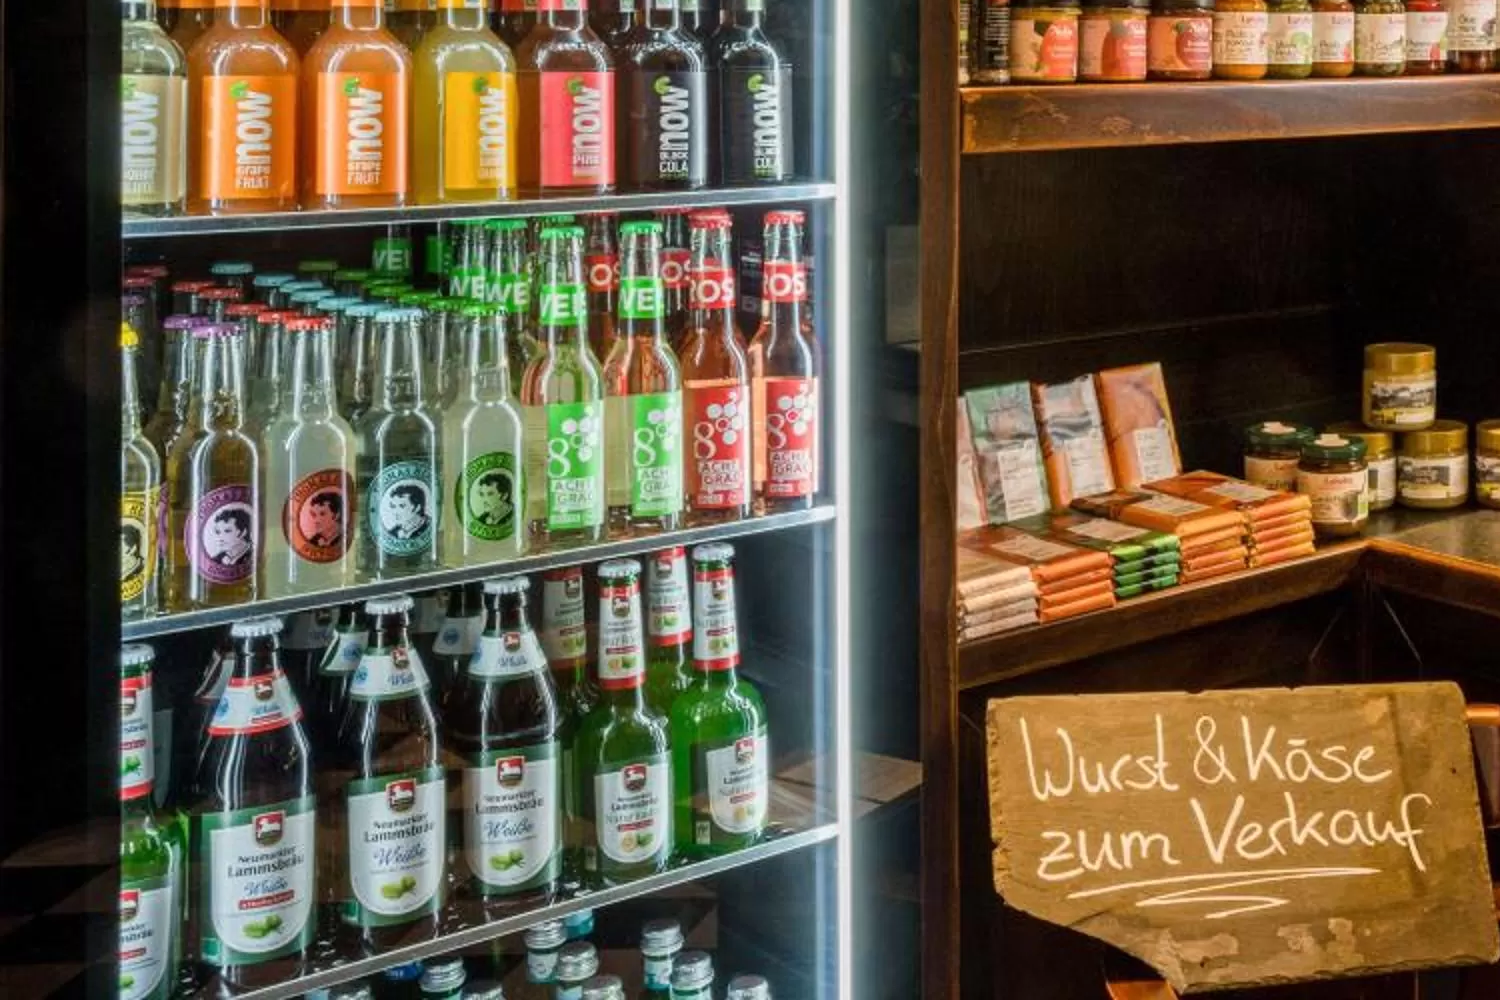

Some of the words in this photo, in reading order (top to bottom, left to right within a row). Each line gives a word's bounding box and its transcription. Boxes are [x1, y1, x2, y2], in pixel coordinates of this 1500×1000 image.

[235, 91, 273, 164] now
[347, 87, 383, 161] now
[572, 87, 601, 153] now
[659, 85, 690, 151] now
[754, 83, 781, 150] now
[547, 437, 571, 478] 8
[633, 427, 657, 468] 8
[694, 421, 717, 460] 8
[1020, 712, 1180, 802] Wurst
[1193, 715, 1236, 785] &
[1240, 713, 1393, 784] Käse
[1036, 828, 1181, 882] zum
[1189, 790, 1434, 873] Verkauf
